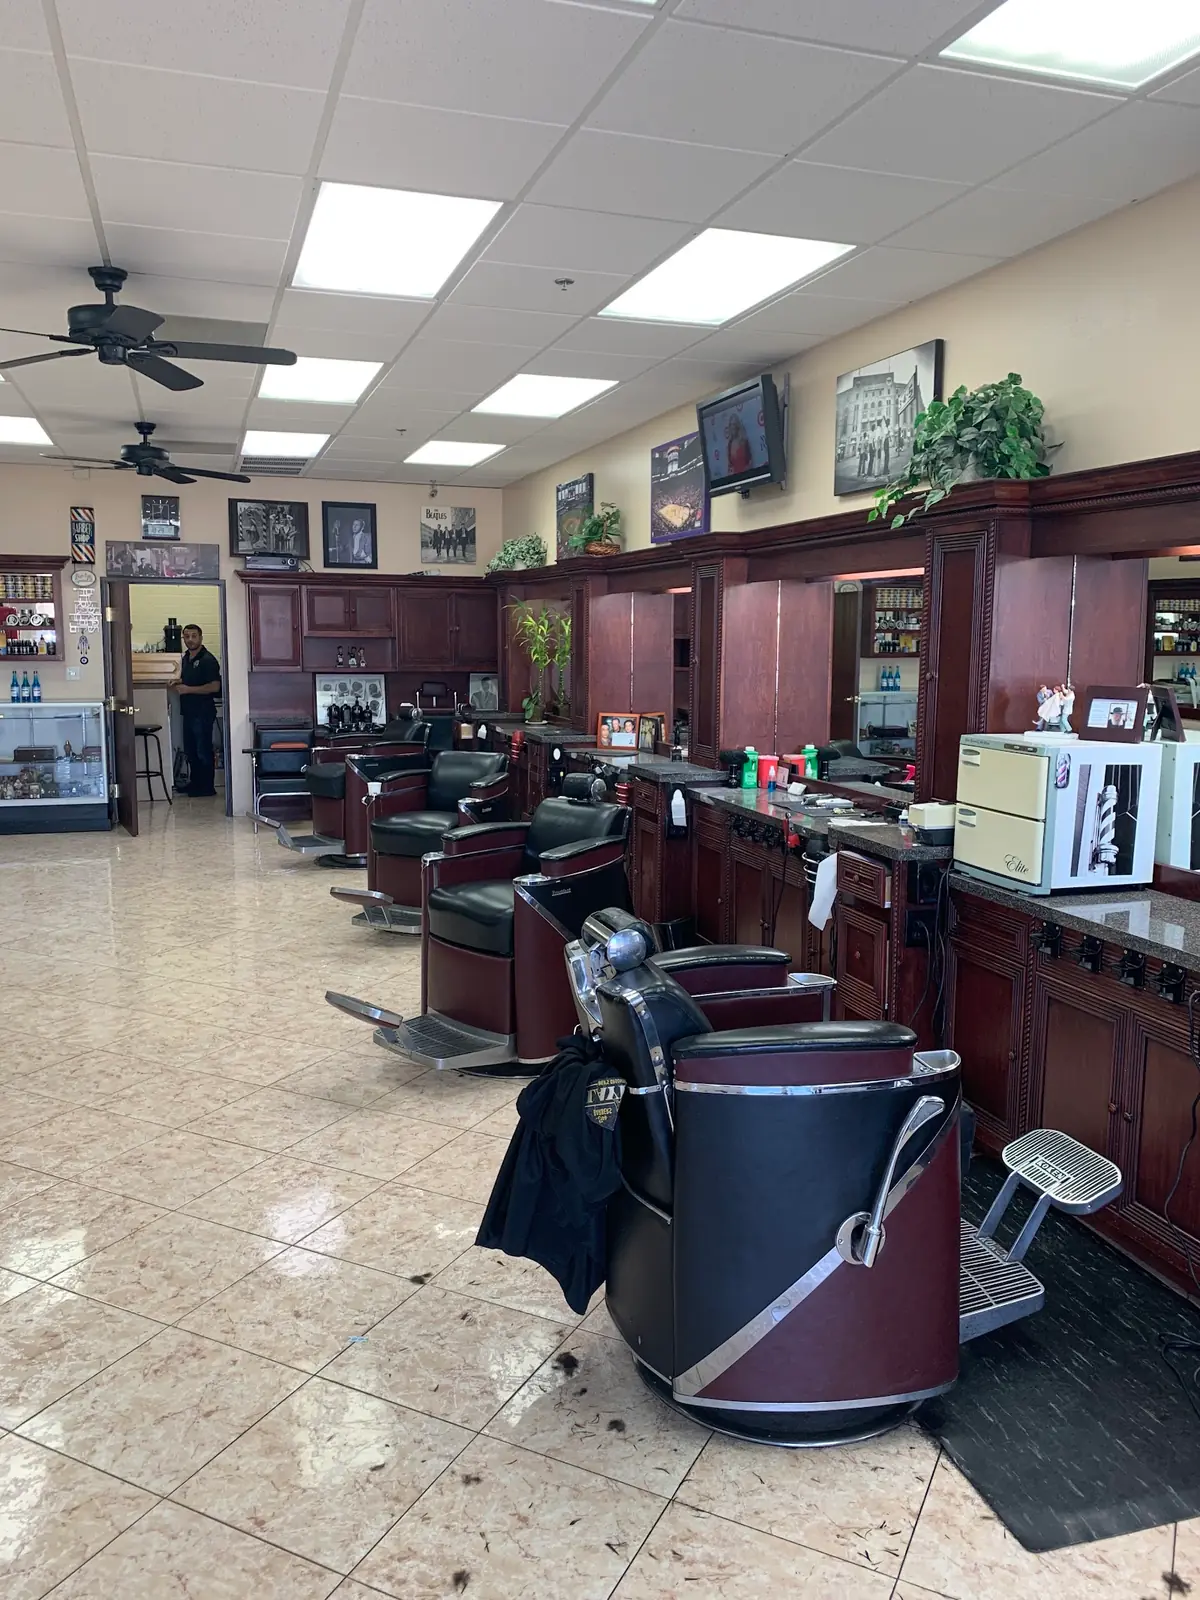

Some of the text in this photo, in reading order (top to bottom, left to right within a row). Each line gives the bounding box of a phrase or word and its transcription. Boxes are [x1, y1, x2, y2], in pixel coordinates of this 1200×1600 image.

[425, 508, 448, 520] BEATLES
[74, 533, 91, 543] SHOP
[1003, 853, 1029, 876] Elite
[1036, 1159, 1066, 1181] KOKEN
